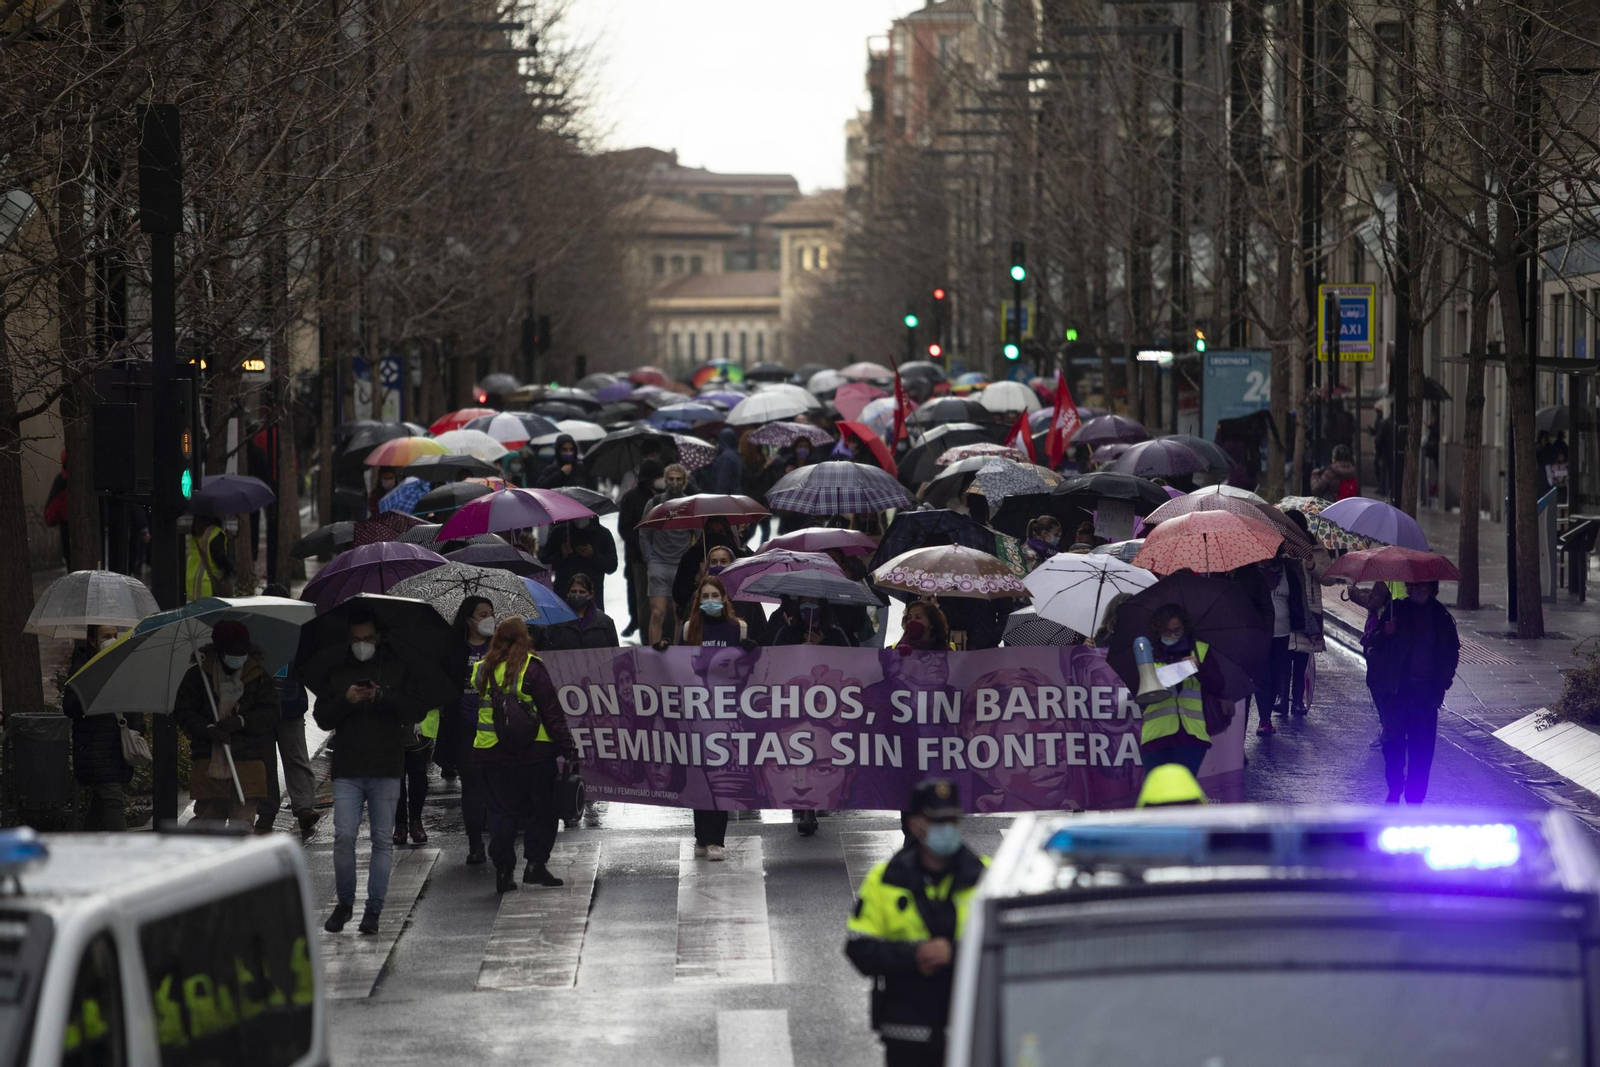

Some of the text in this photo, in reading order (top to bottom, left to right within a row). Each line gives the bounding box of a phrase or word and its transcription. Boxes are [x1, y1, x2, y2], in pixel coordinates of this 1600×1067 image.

[1340, 323, 1362, 335] AXI
[557, 684, 1142, 725] ON DERECHOS, SIN BARRER
[571, 727, 1143, 771] FEMINISTAS SIN FRONTERA
[598, 785, 604, 793] Y
[618, 787, 650, 798] FEMINISMO
[651, 789, 679, 800] UNITARIO
[1207, 798, 1221, 807] 021
